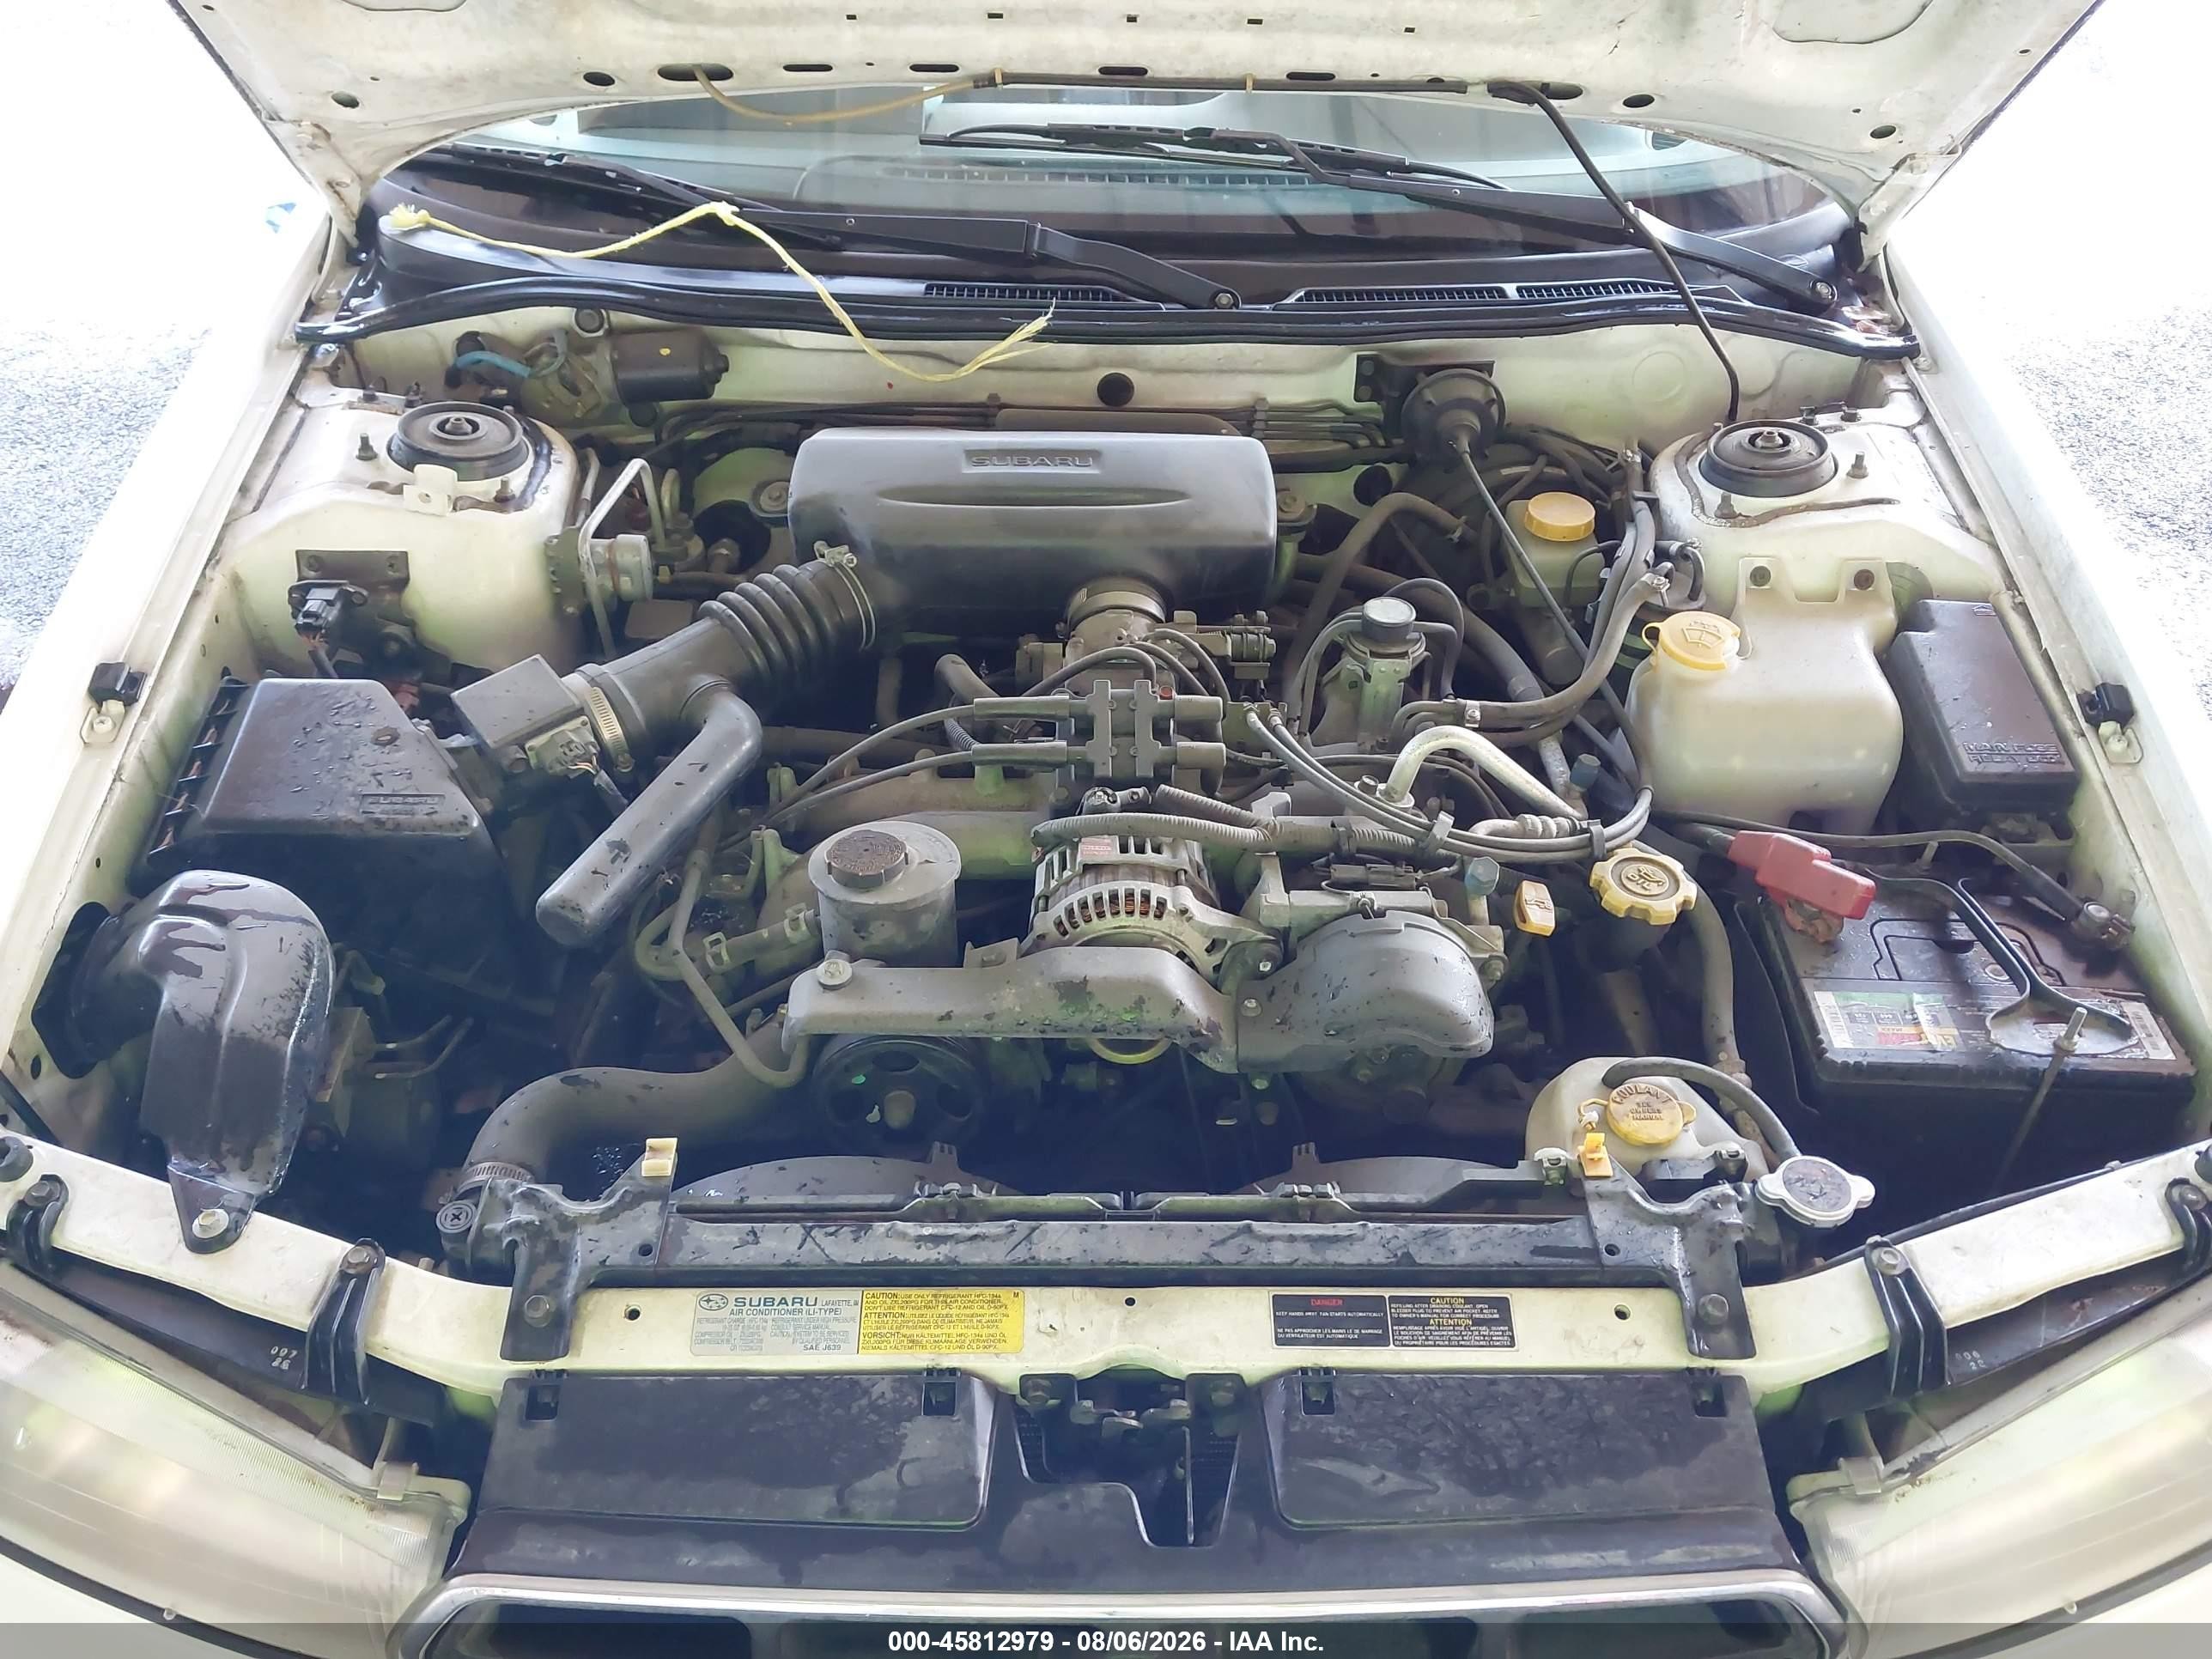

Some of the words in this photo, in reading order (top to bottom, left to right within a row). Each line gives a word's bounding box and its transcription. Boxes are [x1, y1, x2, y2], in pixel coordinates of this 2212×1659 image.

[970, 455, 1093, 468] SUBARU
[1964, 742, 2007, 752] MAIN
[1968, 755, 2019, 764] RELAY
[369, 796, 439, 805] SUBARU
[1626, 872, 1652, 891] OIL
[1612, 1085, 1671, 1105] COOLANT
[733, 1297, 818, 1307] SUBARU
[729, 1308, 744, 1316] AIR
[745, 1308, 803, 1316] CONDITIONER
[805, 1308, 842, 1316] (LI-TYPE)
[270, 1346, 298, 1358] 007
